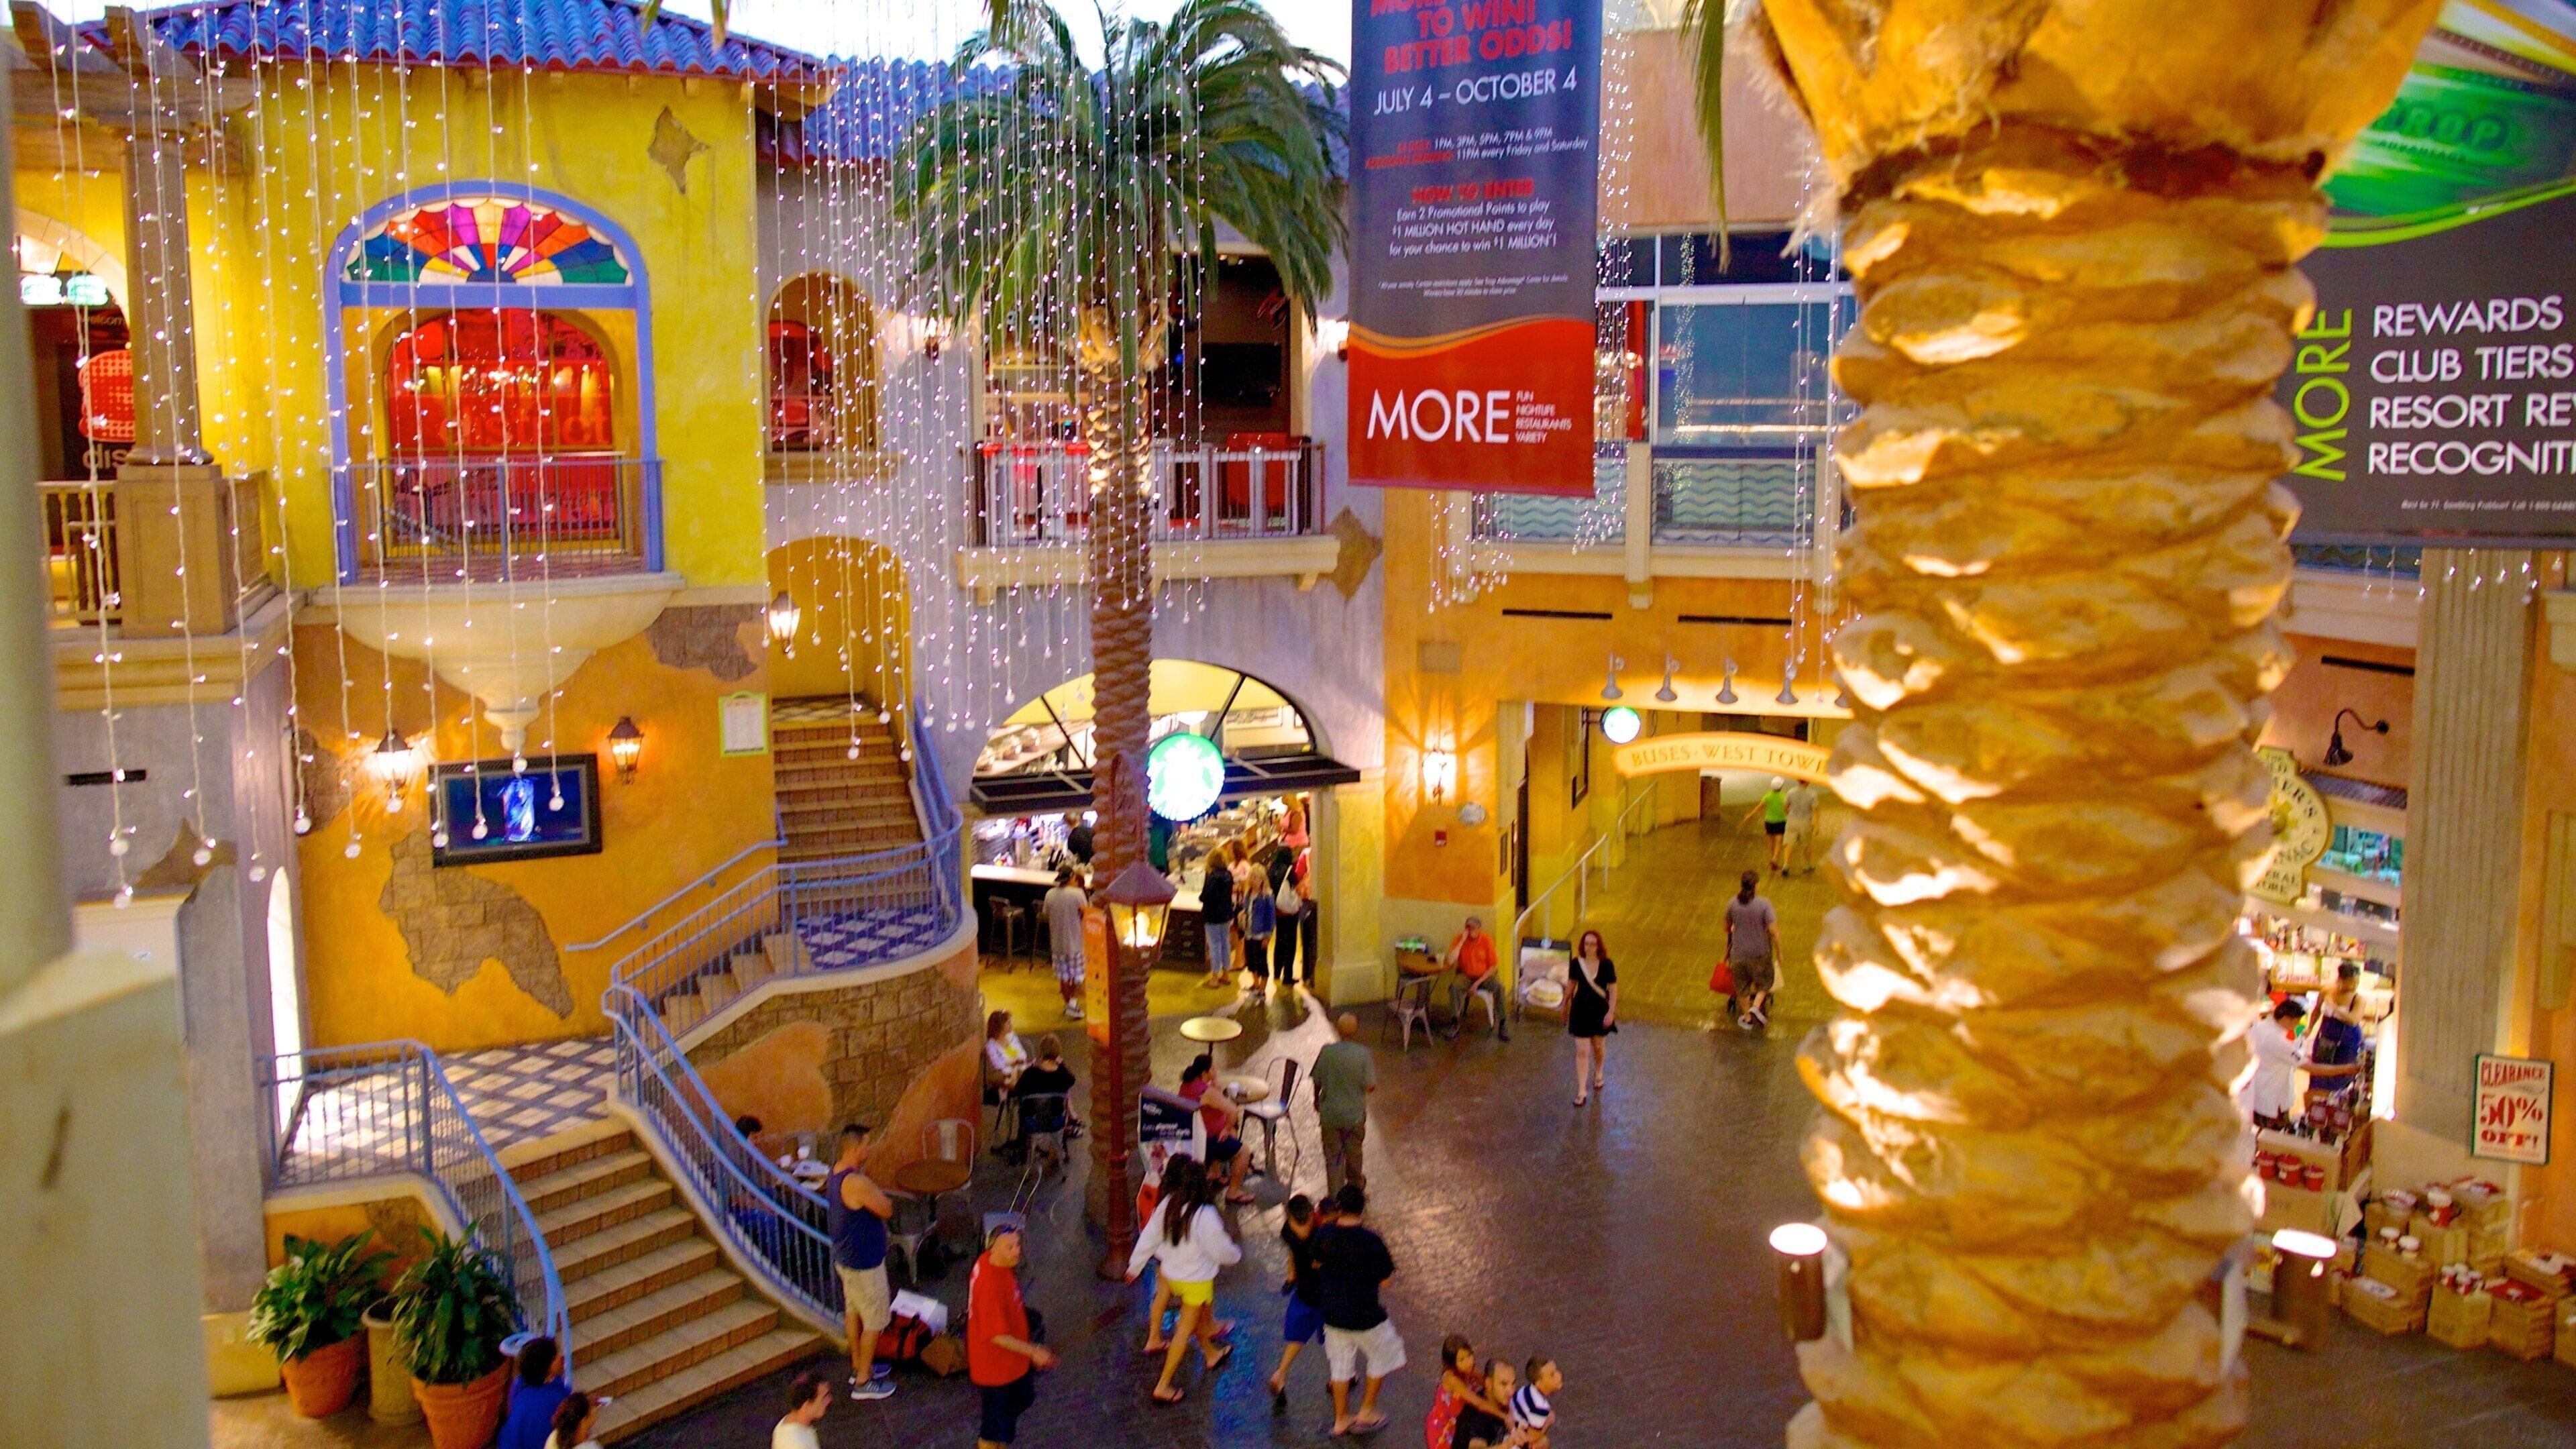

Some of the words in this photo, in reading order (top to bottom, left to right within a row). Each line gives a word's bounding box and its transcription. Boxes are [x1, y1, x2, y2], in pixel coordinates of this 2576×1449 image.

[1417, 7, 1454, 38] TO
[1462, 0, 1535, 31] WIN!
[1384, 34, 1471, 74] BETTER
[1479, 19, 1572, 60] ODDS!
[1373, 86, 1415, 115] JULY
[1419, 85, 1434, 109] 4
[1455, 68, 1557, 105] OCTOBER
[1562, 64, 1577, 91] 4
[1481, 148, 1505, 160] every
[1506, 141, 1533, 157] Friday
[1534, 139, 1550, 154] and
[1551, 135, 1589, 152] Saturday
[1396, 208, 1417, 223] Earn
[1418, 206, 1426, 220] 2
[1428, 201, 1484, 219] Promotional
[1486, 201, 1516, 215] Points
[1517, 201, 1528, 215] to
[1529, 197, 1551, 216] play
[1404, 221, 1444, 238] MILLION
[1446, 220, 1470, 236] HOT
[1471, 218, 1505, 234] HAND
[1507, 219, 1534, 235] every
[1535, 215, 1556, 232] day
[1389, 241, 1402, 257] for
[1403, 243, 1424, 259] your
[1424, 239, 1460, 256] chance
[1460, 240, 1471, 253] to
[1472, 237, 1491, 252] win
[2373, 294, 2565, 338] REWARDS
[2370, 348, 2464, 384] CLUB
[2474, 343, 2575, 380] TIERS
[1516, 390, 1534, 402] FUN
[2293, 307, 2353, 482] MORE
[1366, 388, 1511, 443] MORE
[1515, 403, 1556, 417] NIGHTLIFE
[2369, 392, 2513, 429] RESORT
[1515, 417, 1572, 431] RESTAURANTS
[1515, 430, 1548, 443] VARIETY
[1631, 745, 1690, 768] BUSES
[1702, 743, 1756, 763] WEST
[2481, 1061, 2545, 1088] CLEARANCE
[2479, 1093, 2543, 1128] 50%
[2481, 1130, 2538, 1146] OFF!
